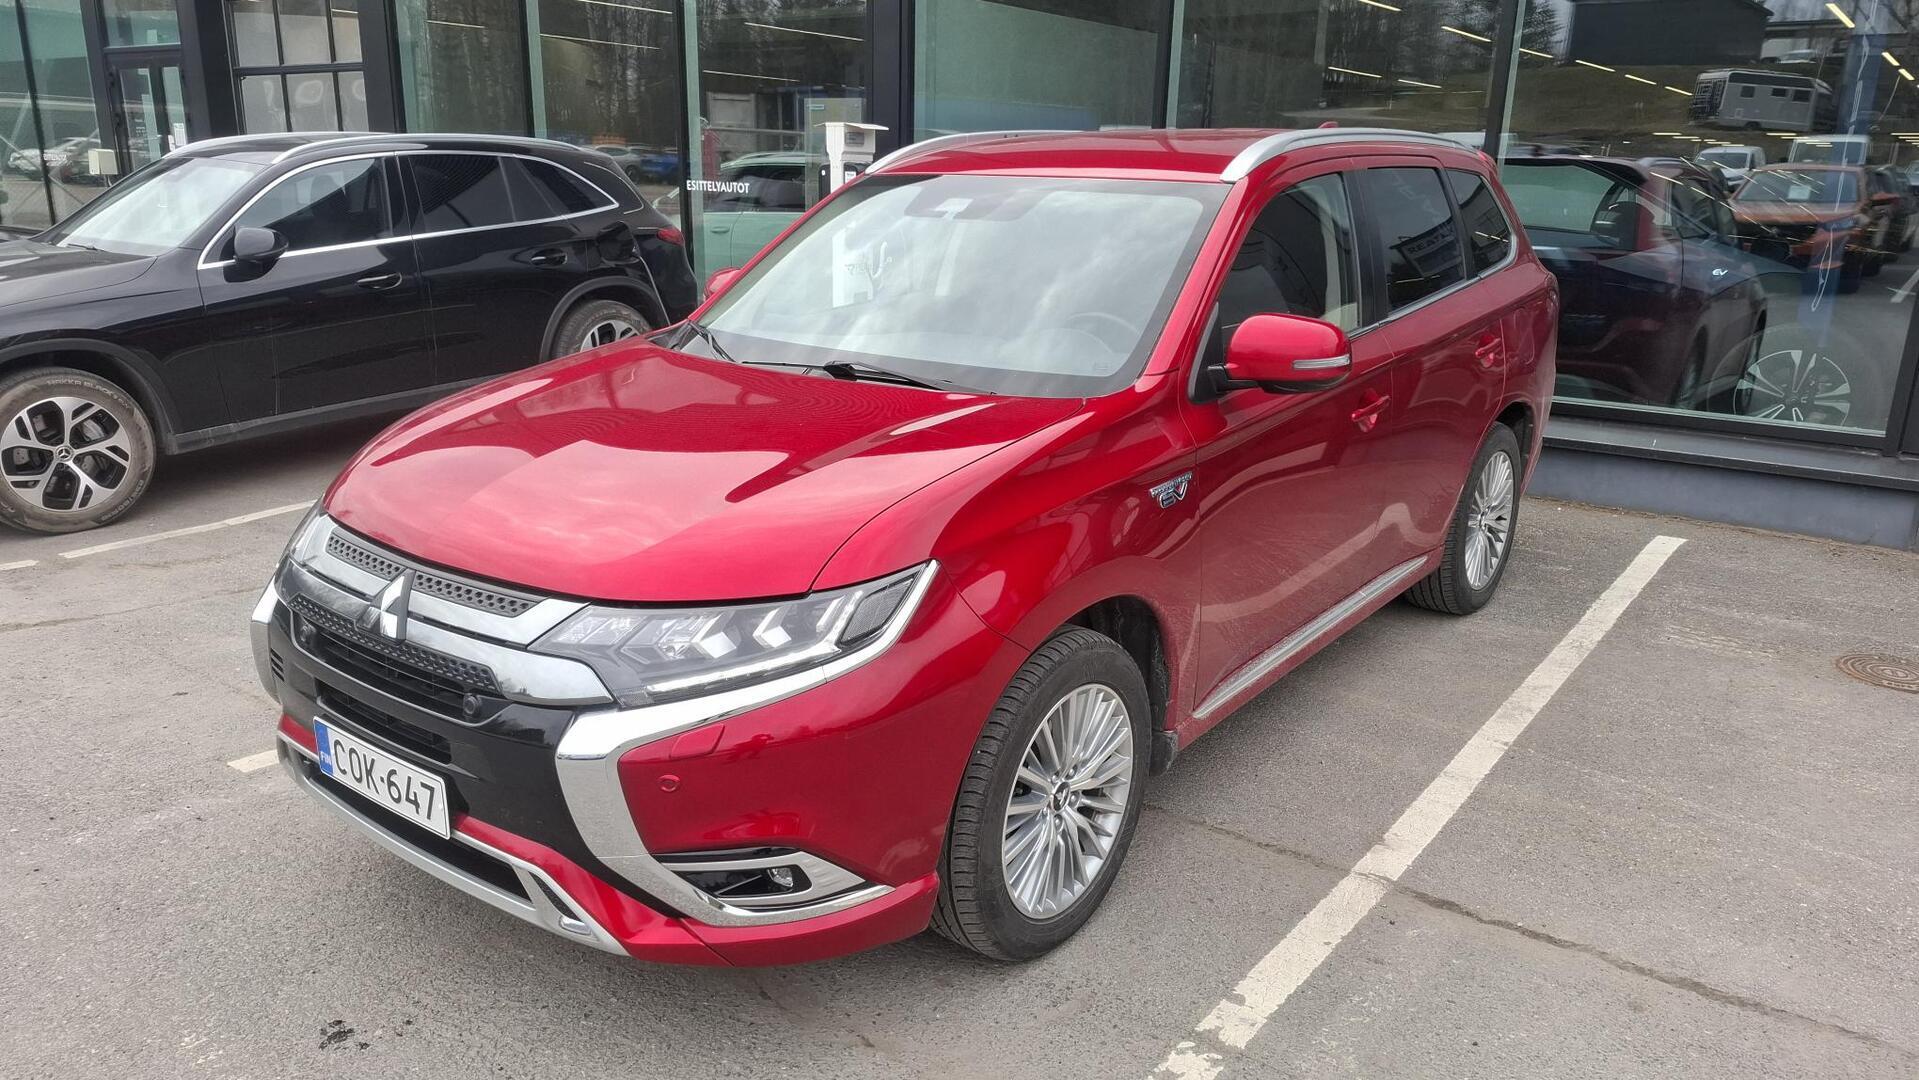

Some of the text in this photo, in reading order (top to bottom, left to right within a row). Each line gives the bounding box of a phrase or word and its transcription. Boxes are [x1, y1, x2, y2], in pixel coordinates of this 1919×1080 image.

[686, 179, 750, 194] ESITTELYAUTOT
[1159, 480, 1188, 509] EV
[320, 750, 333, 765] FIN
[333, 739, 436, 821] COK-647
